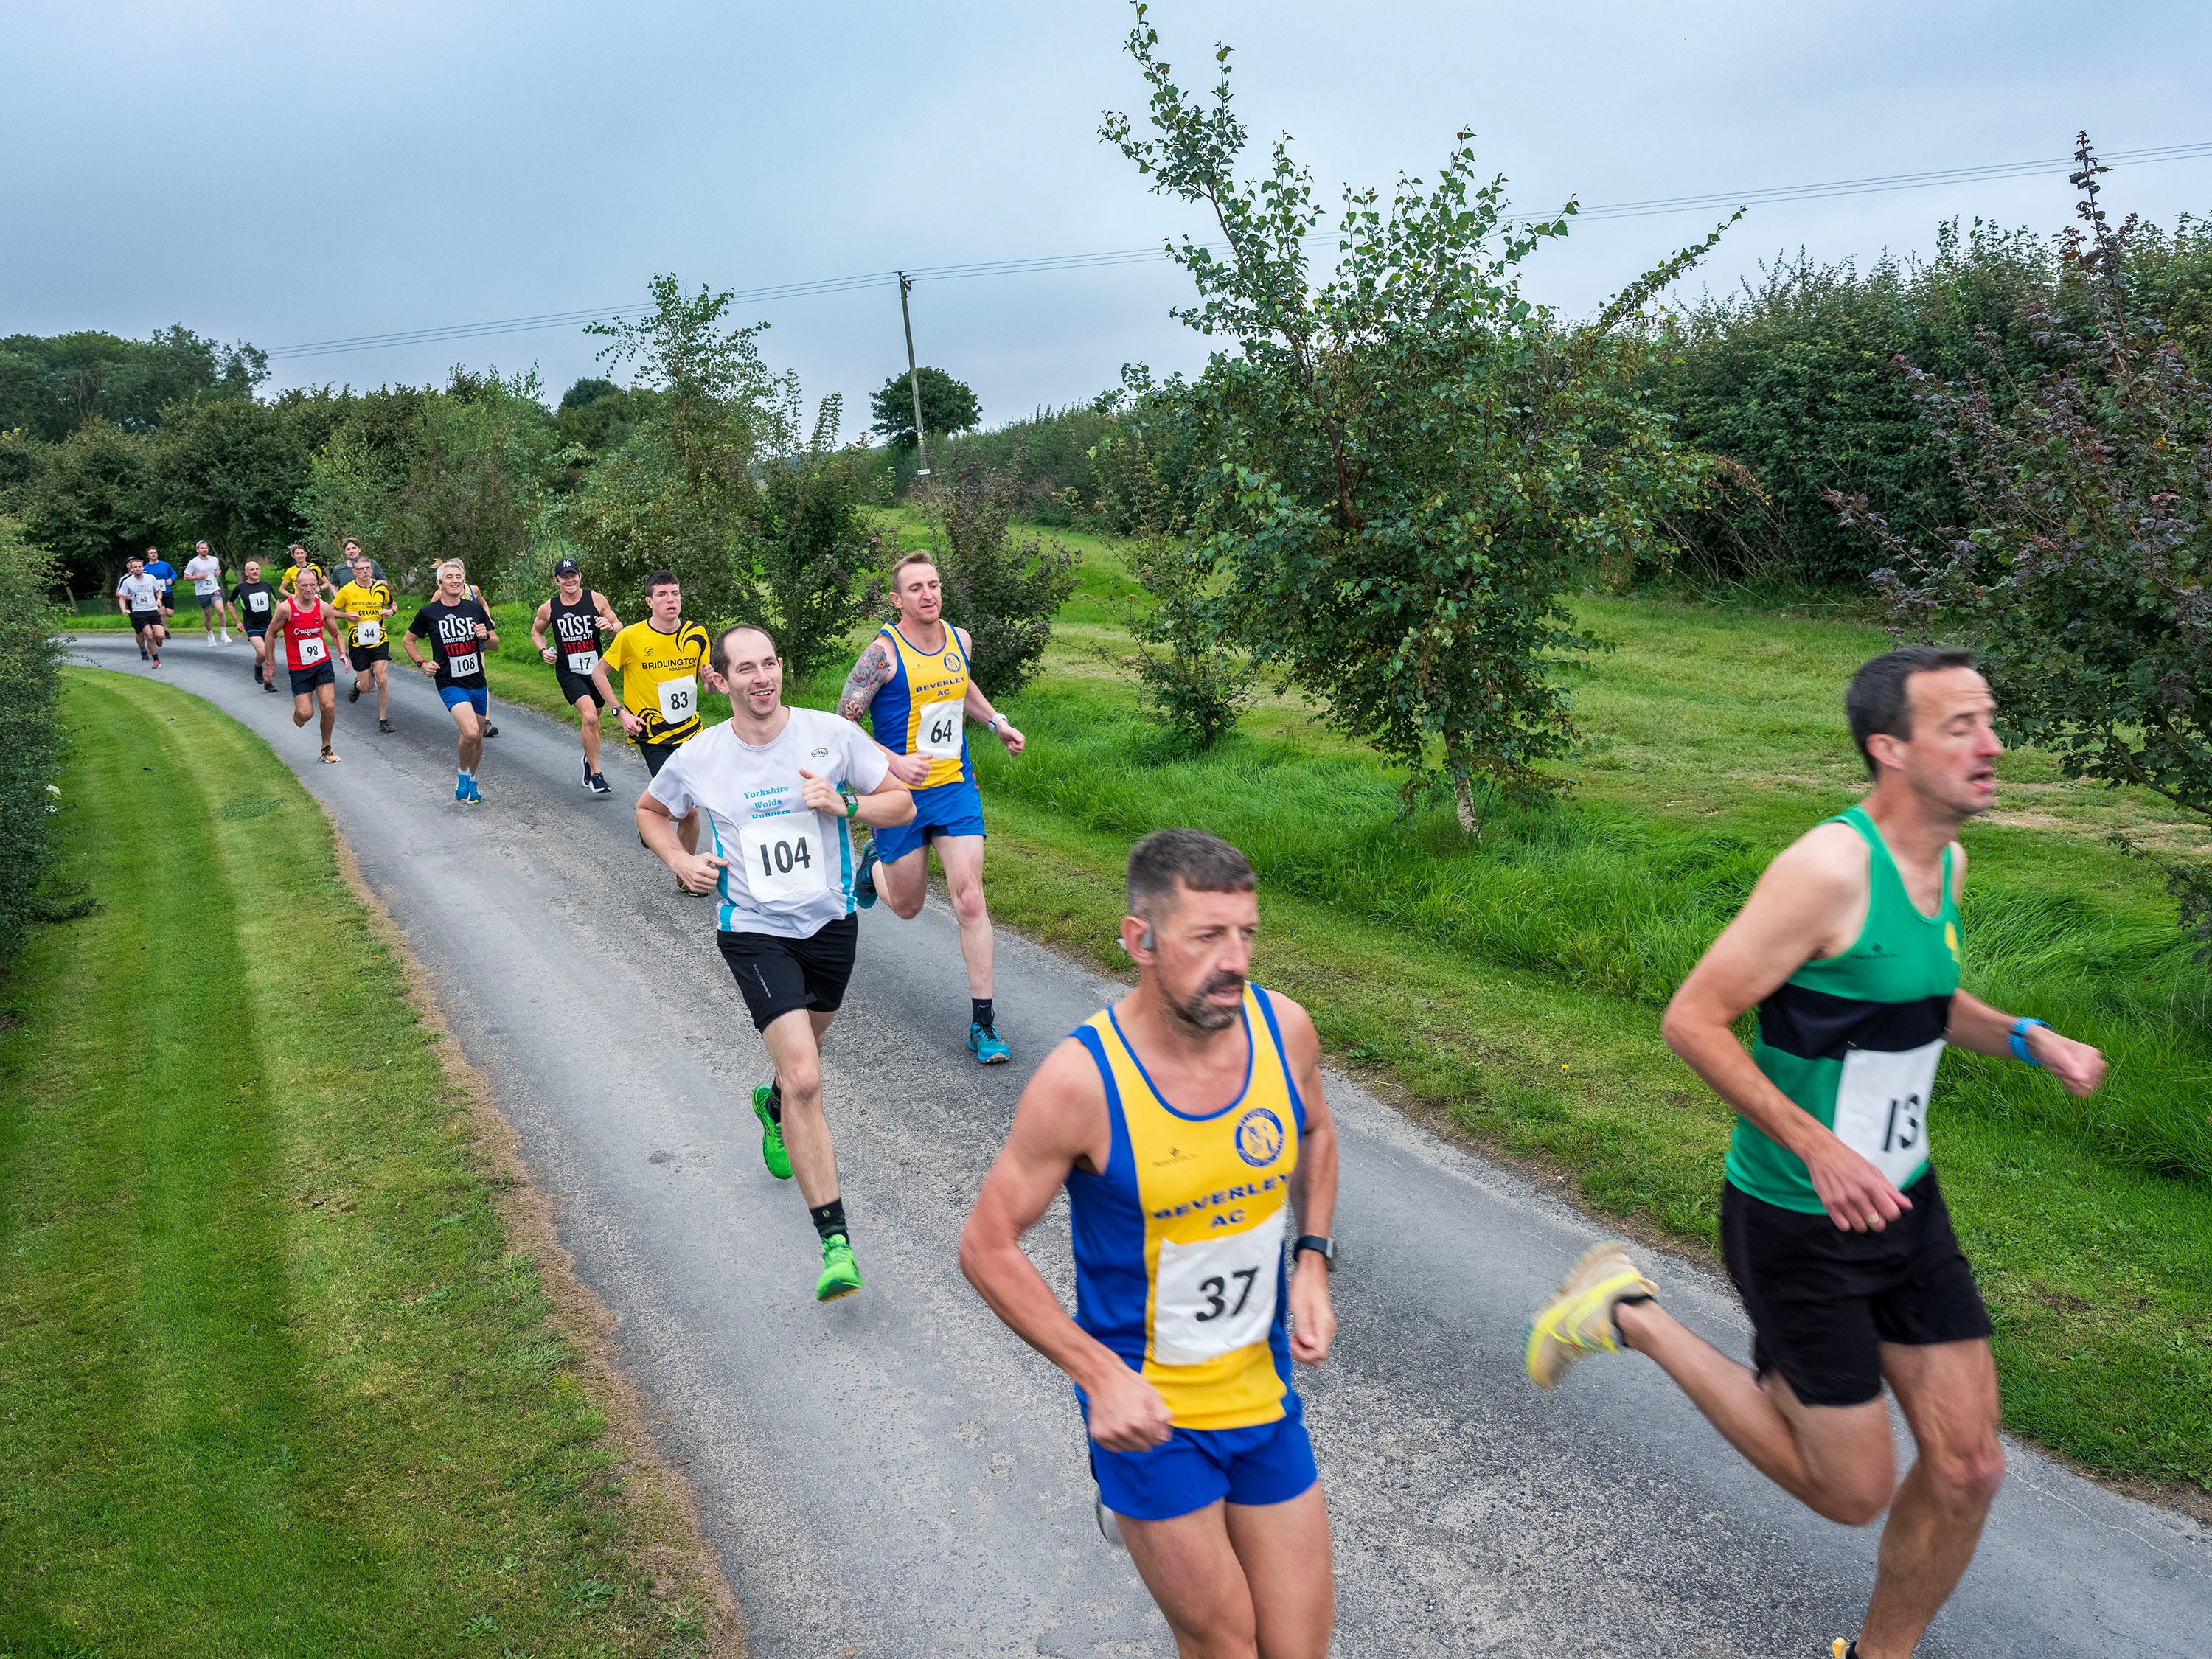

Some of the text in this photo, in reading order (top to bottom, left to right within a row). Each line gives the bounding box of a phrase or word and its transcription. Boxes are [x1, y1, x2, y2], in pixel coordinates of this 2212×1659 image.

[256, 598, 264, 606] 16
[364, 628, 375, 638] 44
[438, 617, 475, 639] RISE
[557, 615, 593, 637] RISE
[307, 645, 318, 656] 98
[443, 641, 476, 656] TITANS
[563, 639, 594, 653] TITANS
[457, 658, 475, 672] 108
[579, 657, 591, 670] 17
[915, 676, 964, 692] BEVERLEY
[670, 691, 689, 710] 83
[931, 719, 952, 743] 64
[743, 785, 789, 799] Yorkshire
[754, 799, 782, 810] Wolds
[760, 836, 811, 877] 104
[1881, 1092, 1920, 1152] 13
[1154, 1174, 1287, 1219] BEVERLEY
[1210, 1209, 1245, 1229] AC
[1194, 1266, 1259, 1322] 37
